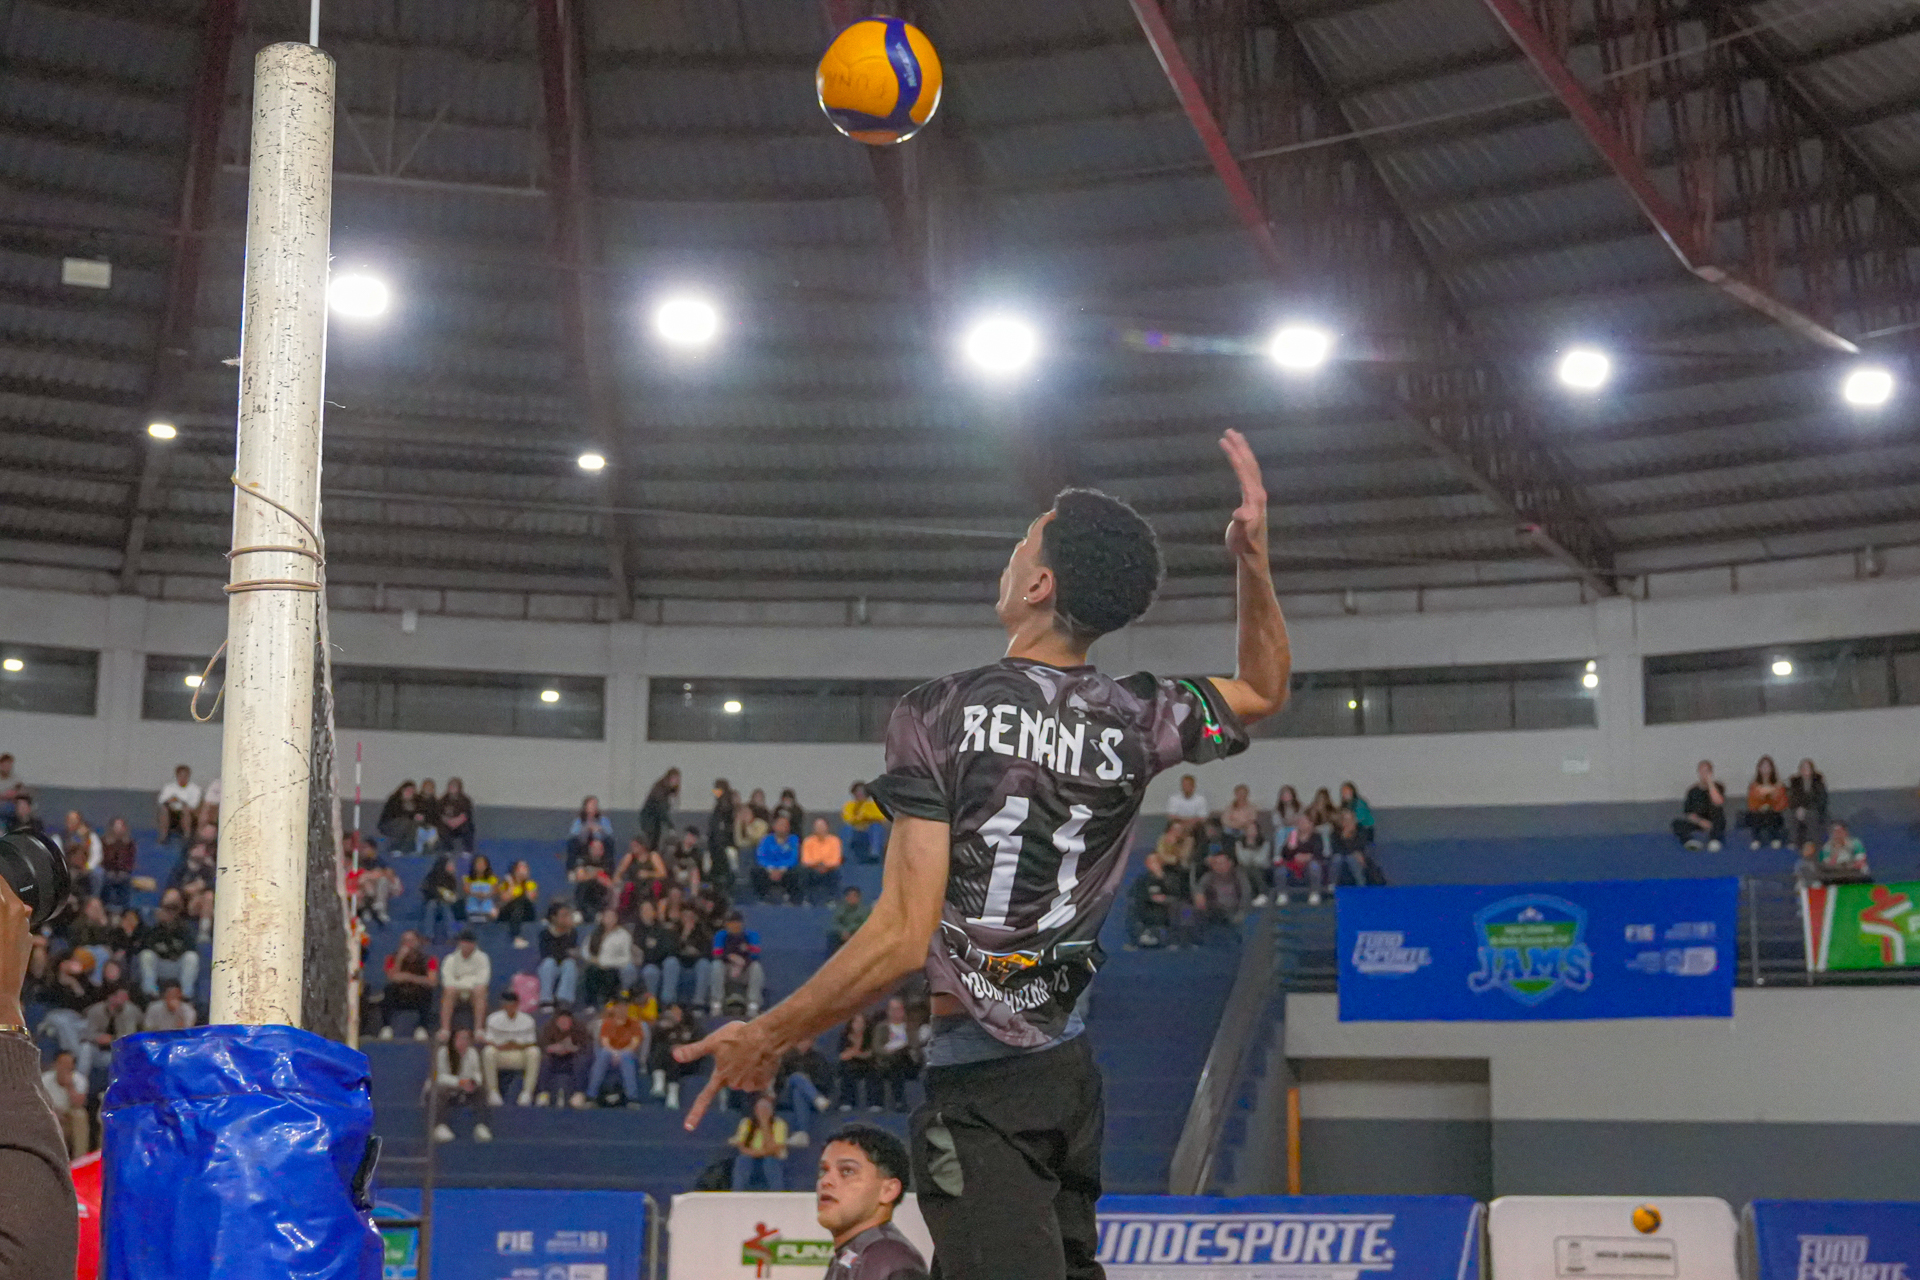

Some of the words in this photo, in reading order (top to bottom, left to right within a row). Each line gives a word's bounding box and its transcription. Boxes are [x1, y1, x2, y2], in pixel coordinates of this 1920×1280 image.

[959, 704, 1085, 776] RENAN
[965, 796, 1093, 933] 11
[1467, 942, 1594, 993] JAMS
[1797, 1235, 1870, 1262] FUND
